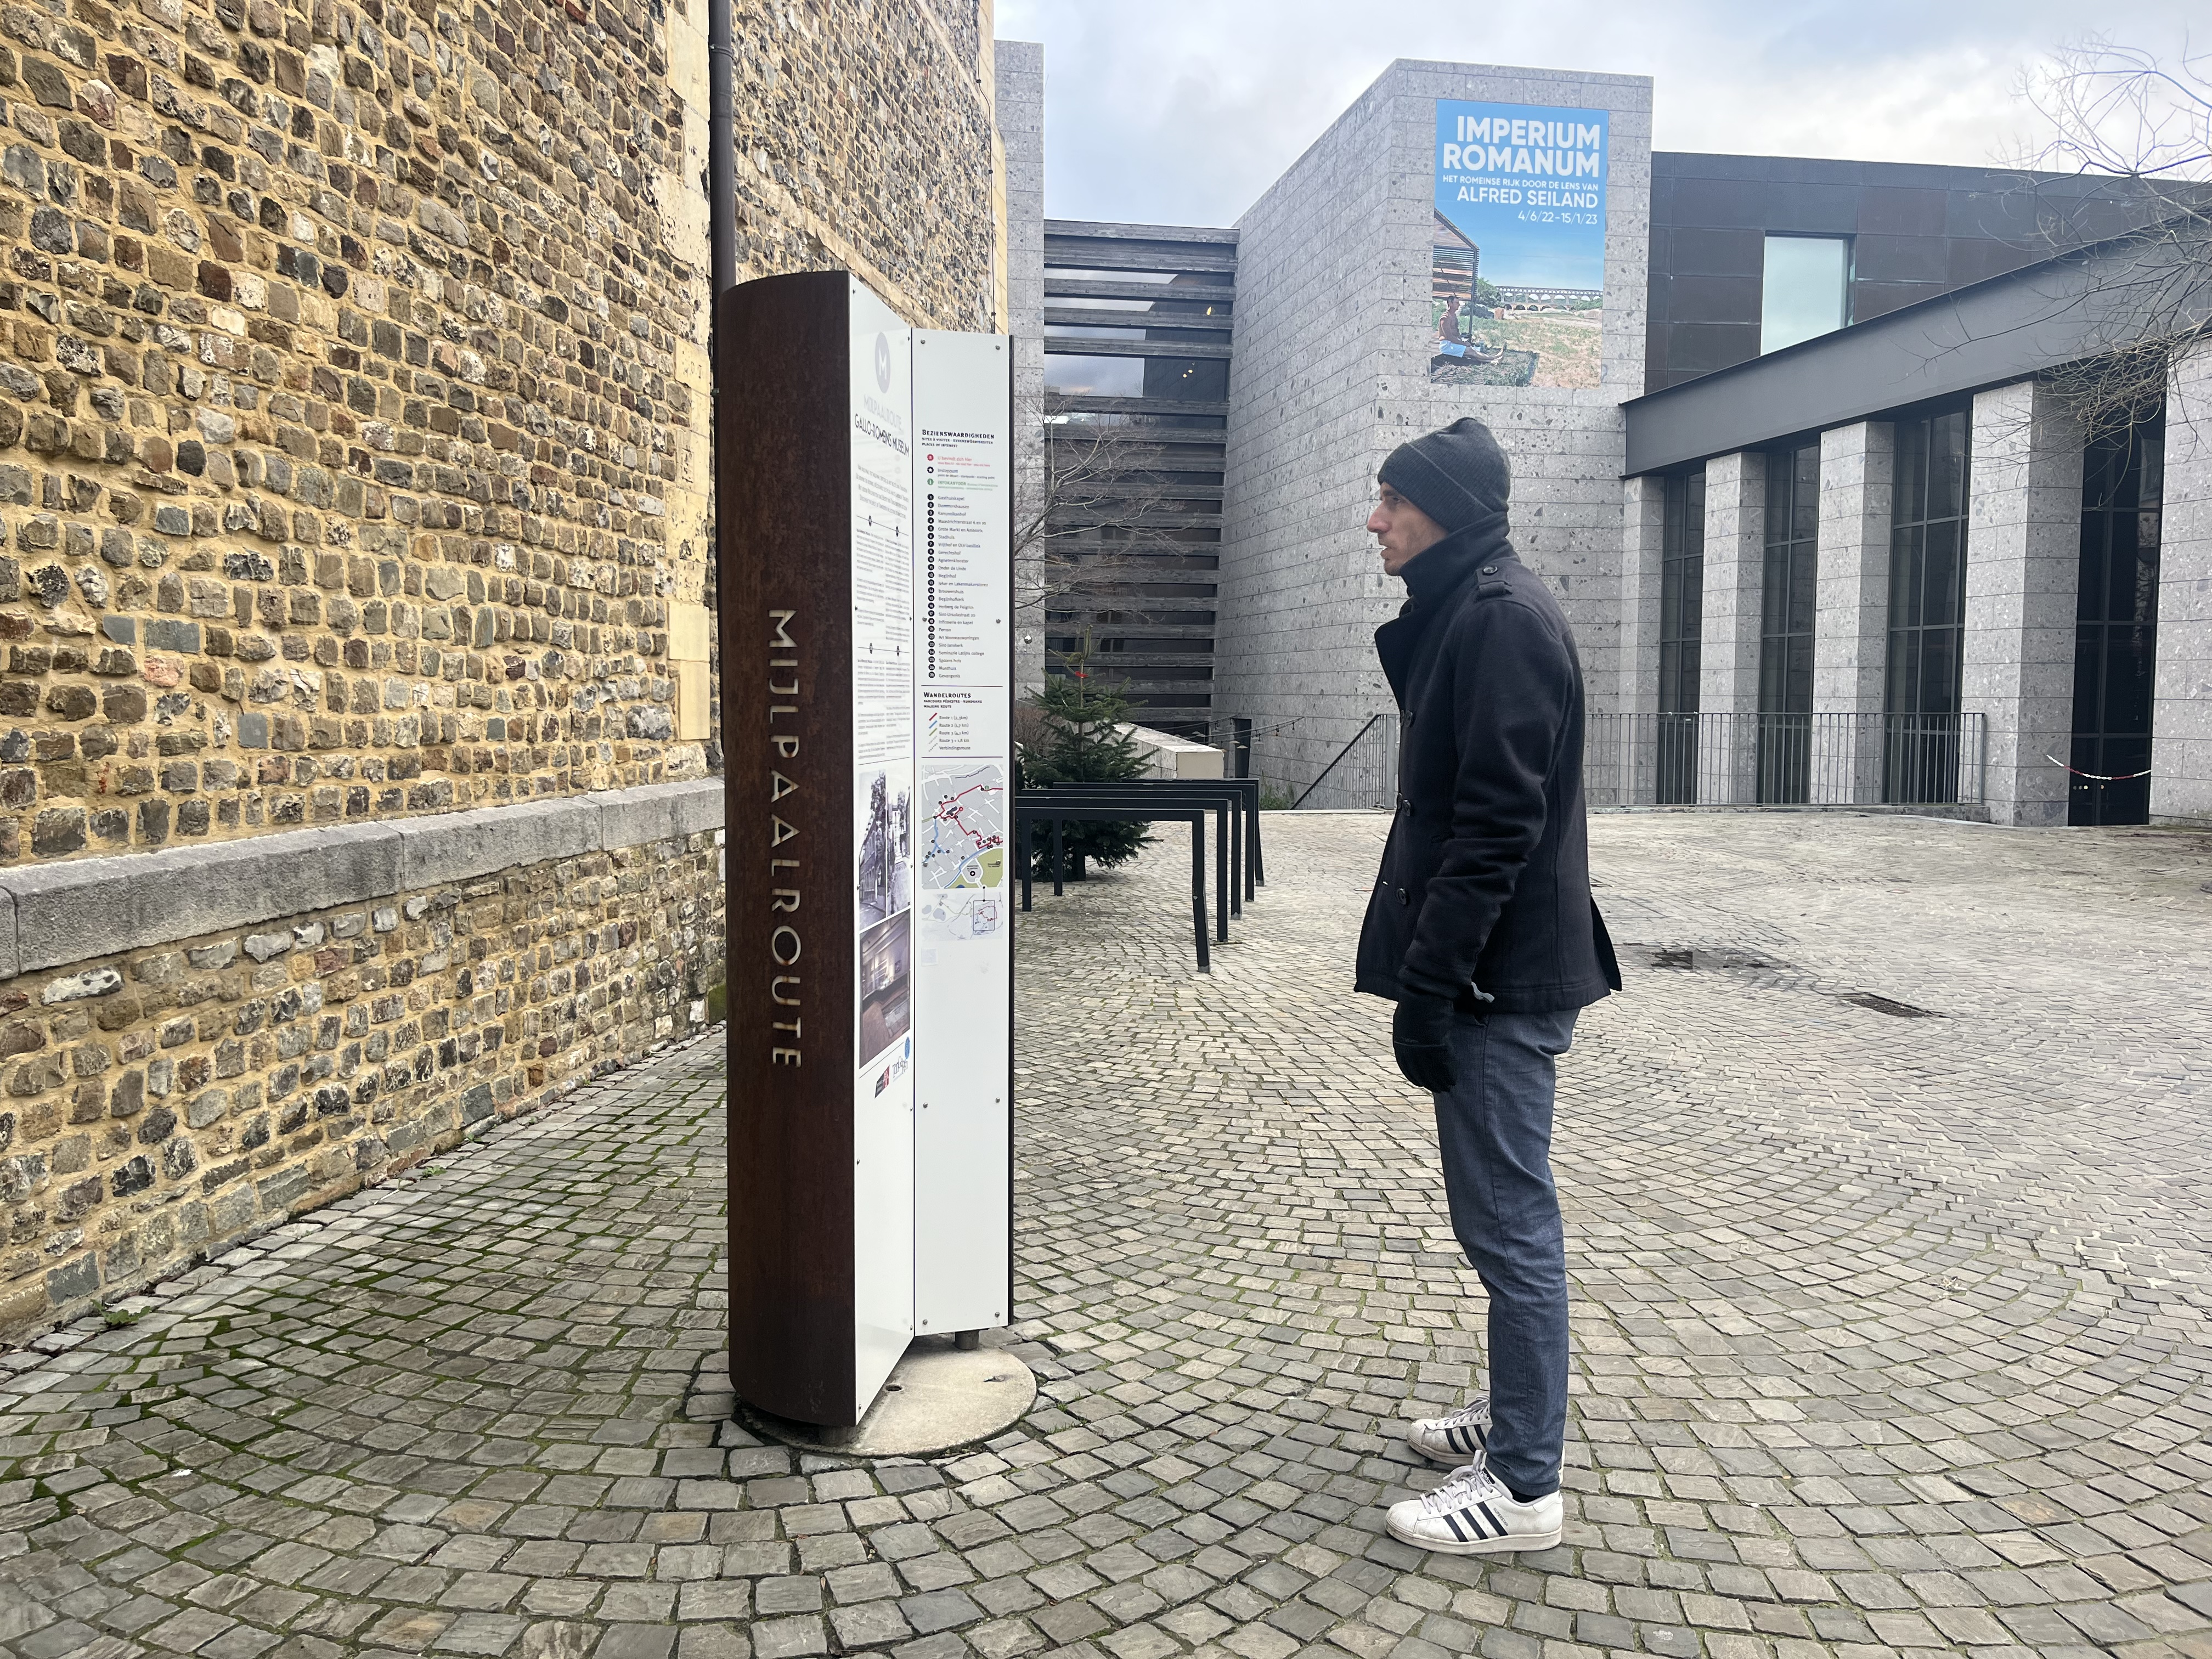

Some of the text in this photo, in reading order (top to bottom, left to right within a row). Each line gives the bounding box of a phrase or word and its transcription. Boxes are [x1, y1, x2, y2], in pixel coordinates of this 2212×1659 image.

[1457, 115, 1600, 150] IMPERIUM
[1443, 143, 1599, 178] ROMANUM
[1442, 174, 1458, 183] HET
[1459, 176, 1501, 186] ROMEINSE
[1502, 178, 1520, 187] RIJK
[1522, 179, 1547, 189] DOOR
[1548, 181, 1559, 189] DE
[1561, 182, 1581, 190] LENS
[1457, 185, 1598, 208] ALFRED SEILAND
[879, 348, 887, 380] M
[892, 437, 910, 458] MUSEUM
[769, 610, 802, 1068] MIJLPAALROUTE
[1493, 1507, 1509, 1527] SUPERSTAR
